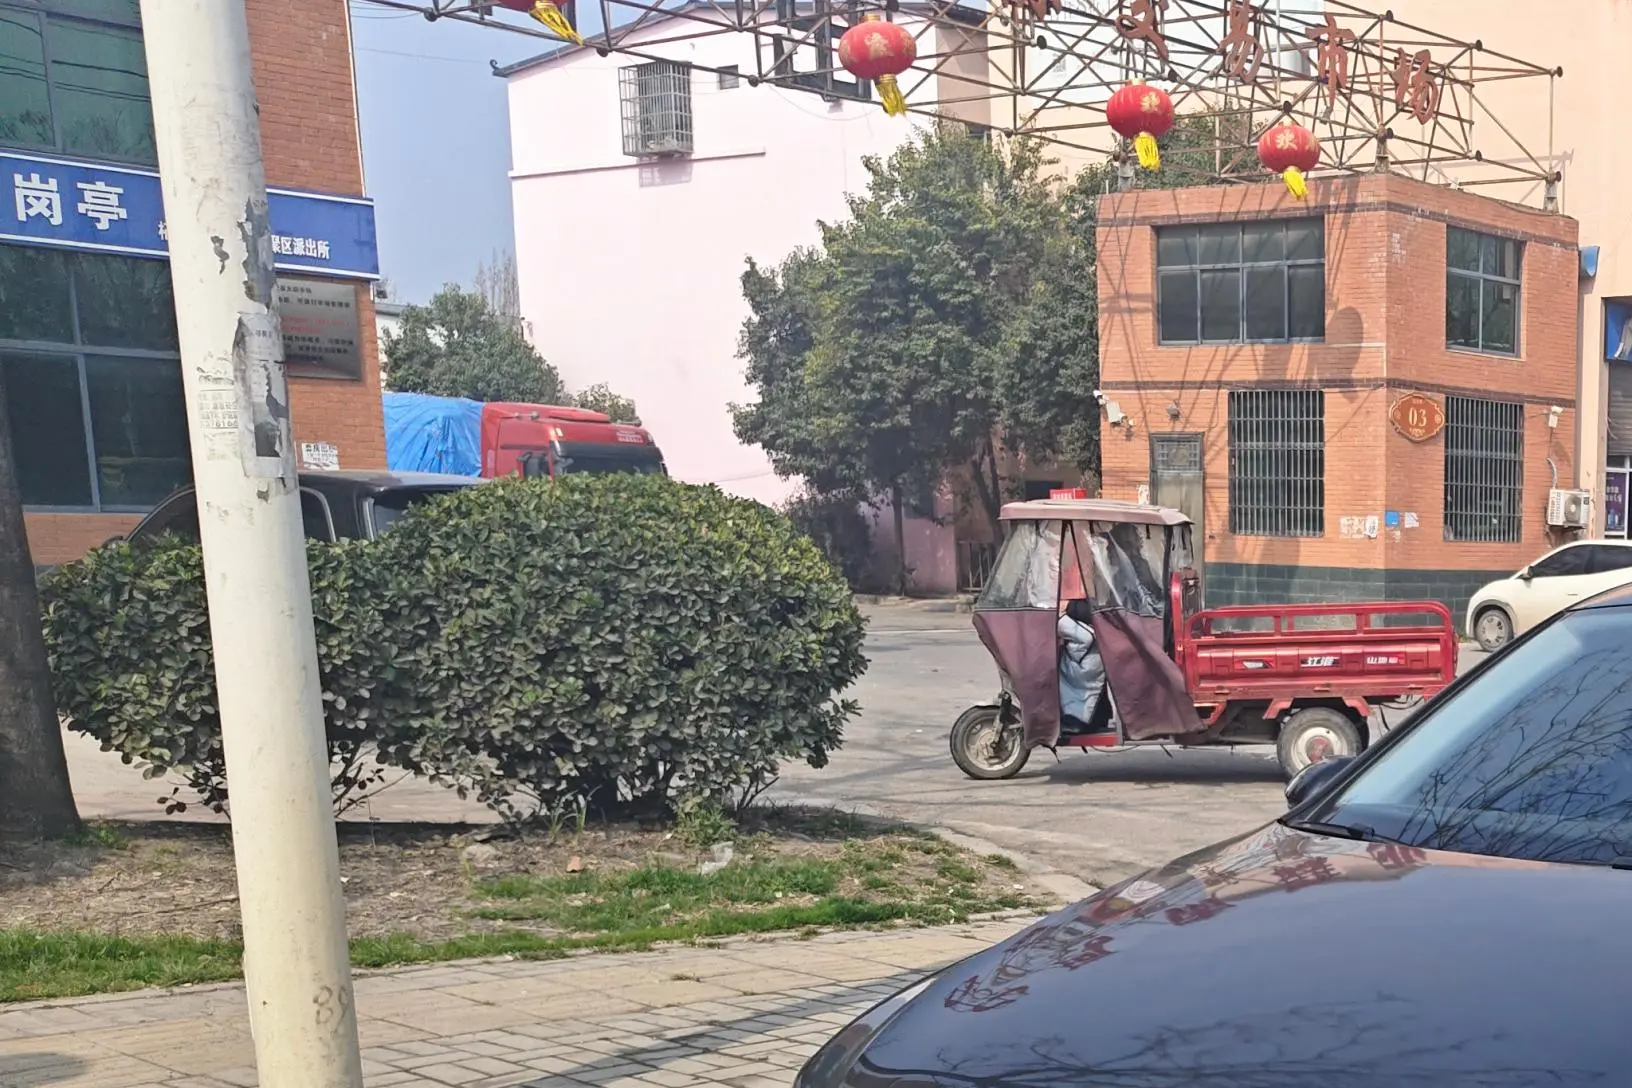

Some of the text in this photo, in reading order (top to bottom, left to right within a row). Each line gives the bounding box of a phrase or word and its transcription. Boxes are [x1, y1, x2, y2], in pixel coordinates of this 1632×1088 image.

[1012, 0, 1438, 126] 交易市场
[13, 172, 128, 231] 岗亭
[1409, 407, 1427, 427] 03
